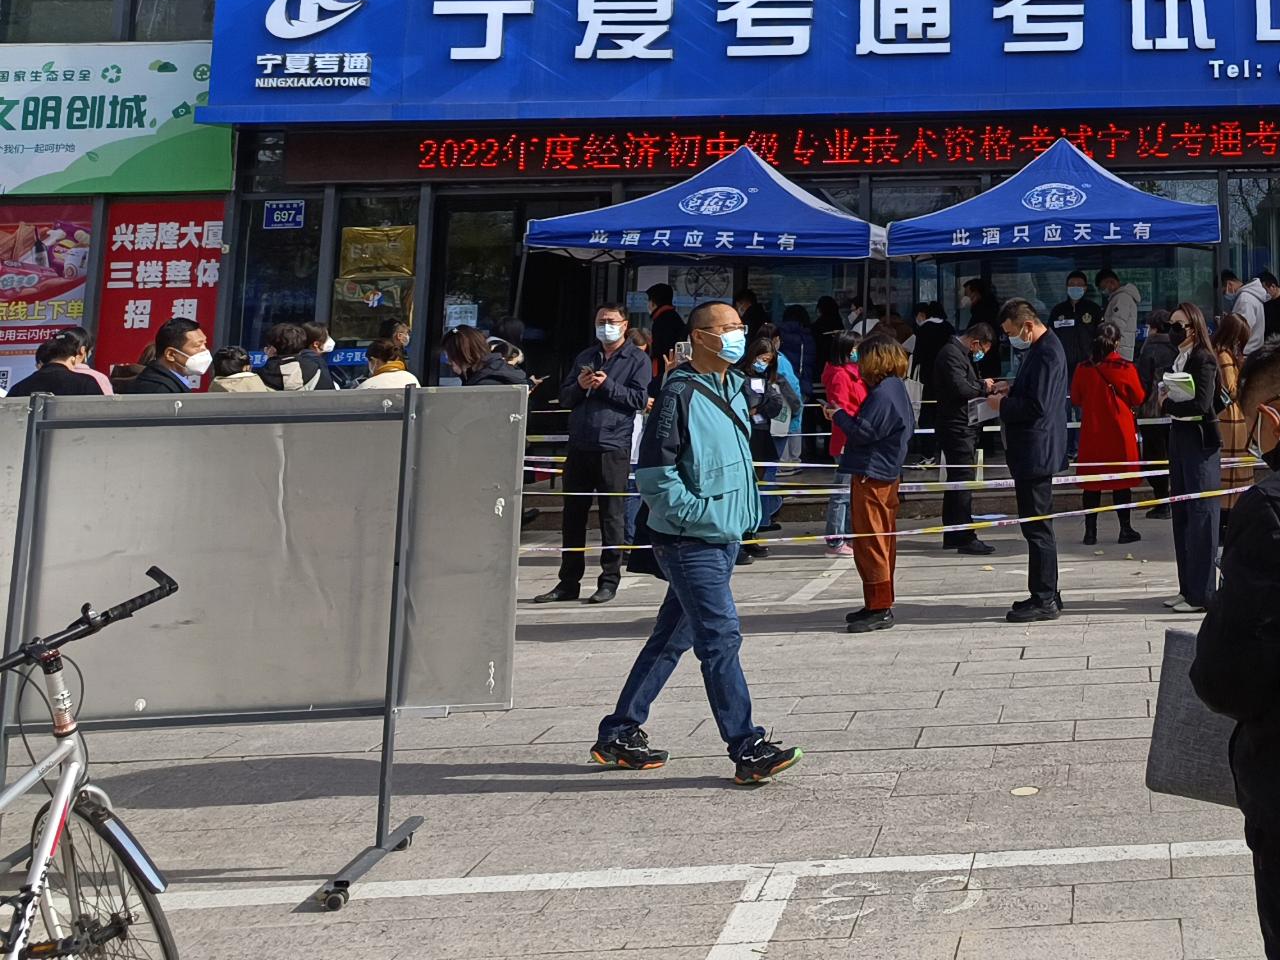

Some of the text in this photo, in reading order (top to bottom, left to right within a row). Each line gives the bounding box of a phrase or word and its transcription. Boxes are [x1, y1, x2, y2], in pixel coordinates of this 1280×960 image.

[256, 52, 371, 74] 宁夏考通
[1209, 59, 1264, 79] Tel:
[255, 76, 370, 88] NINGXIAKAOTONG
[273, 210, 296, 222] 697
[112, 221, 225, 251] 兴泰隆大厦
[588, 229, 798, 251] 此酒只应天上有
[951, 222, 1152, 246] 此酒只应天上有
[107, 259, 221, 288] 三楼整体
